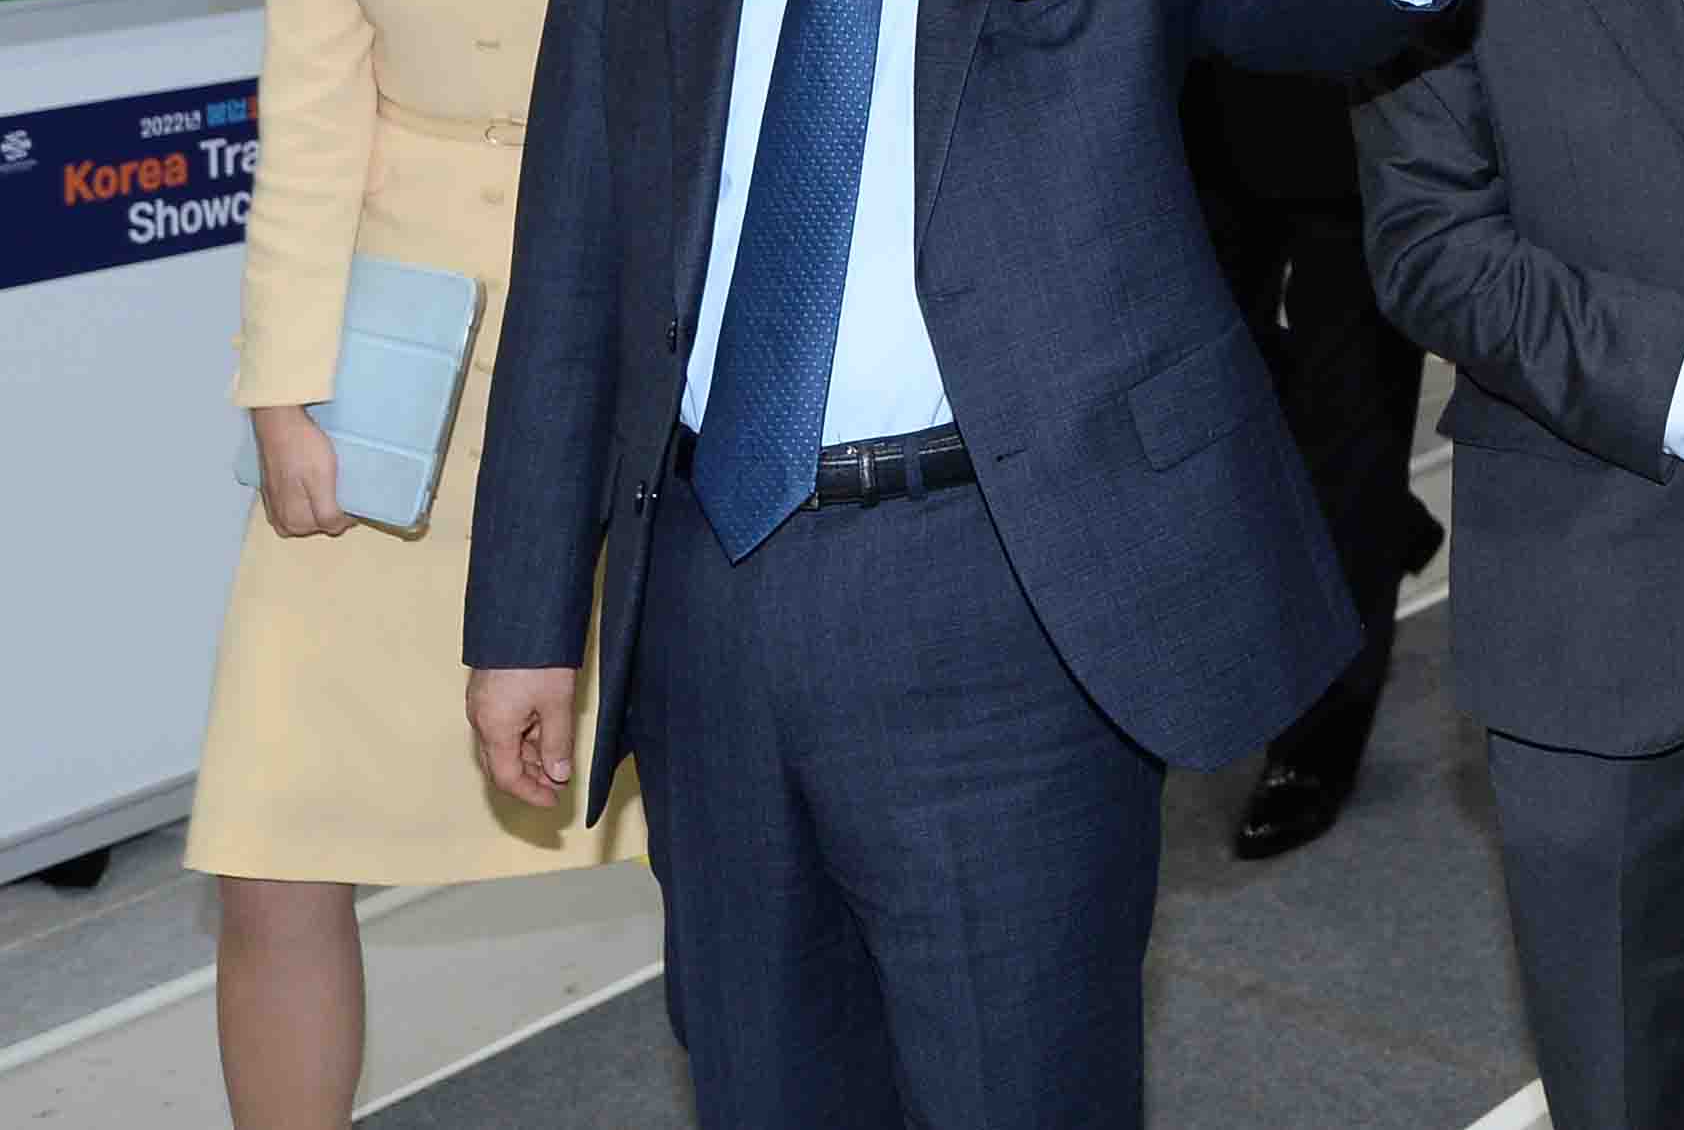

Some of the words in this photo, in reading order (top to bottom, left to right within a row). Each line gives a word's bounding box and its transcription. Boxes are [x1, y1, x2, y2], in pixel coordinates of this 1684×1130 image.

[63, 152, 190, 206] Korea
[200, 137, 259, 180] Tra
[127, 192, 251, 245] Showc
